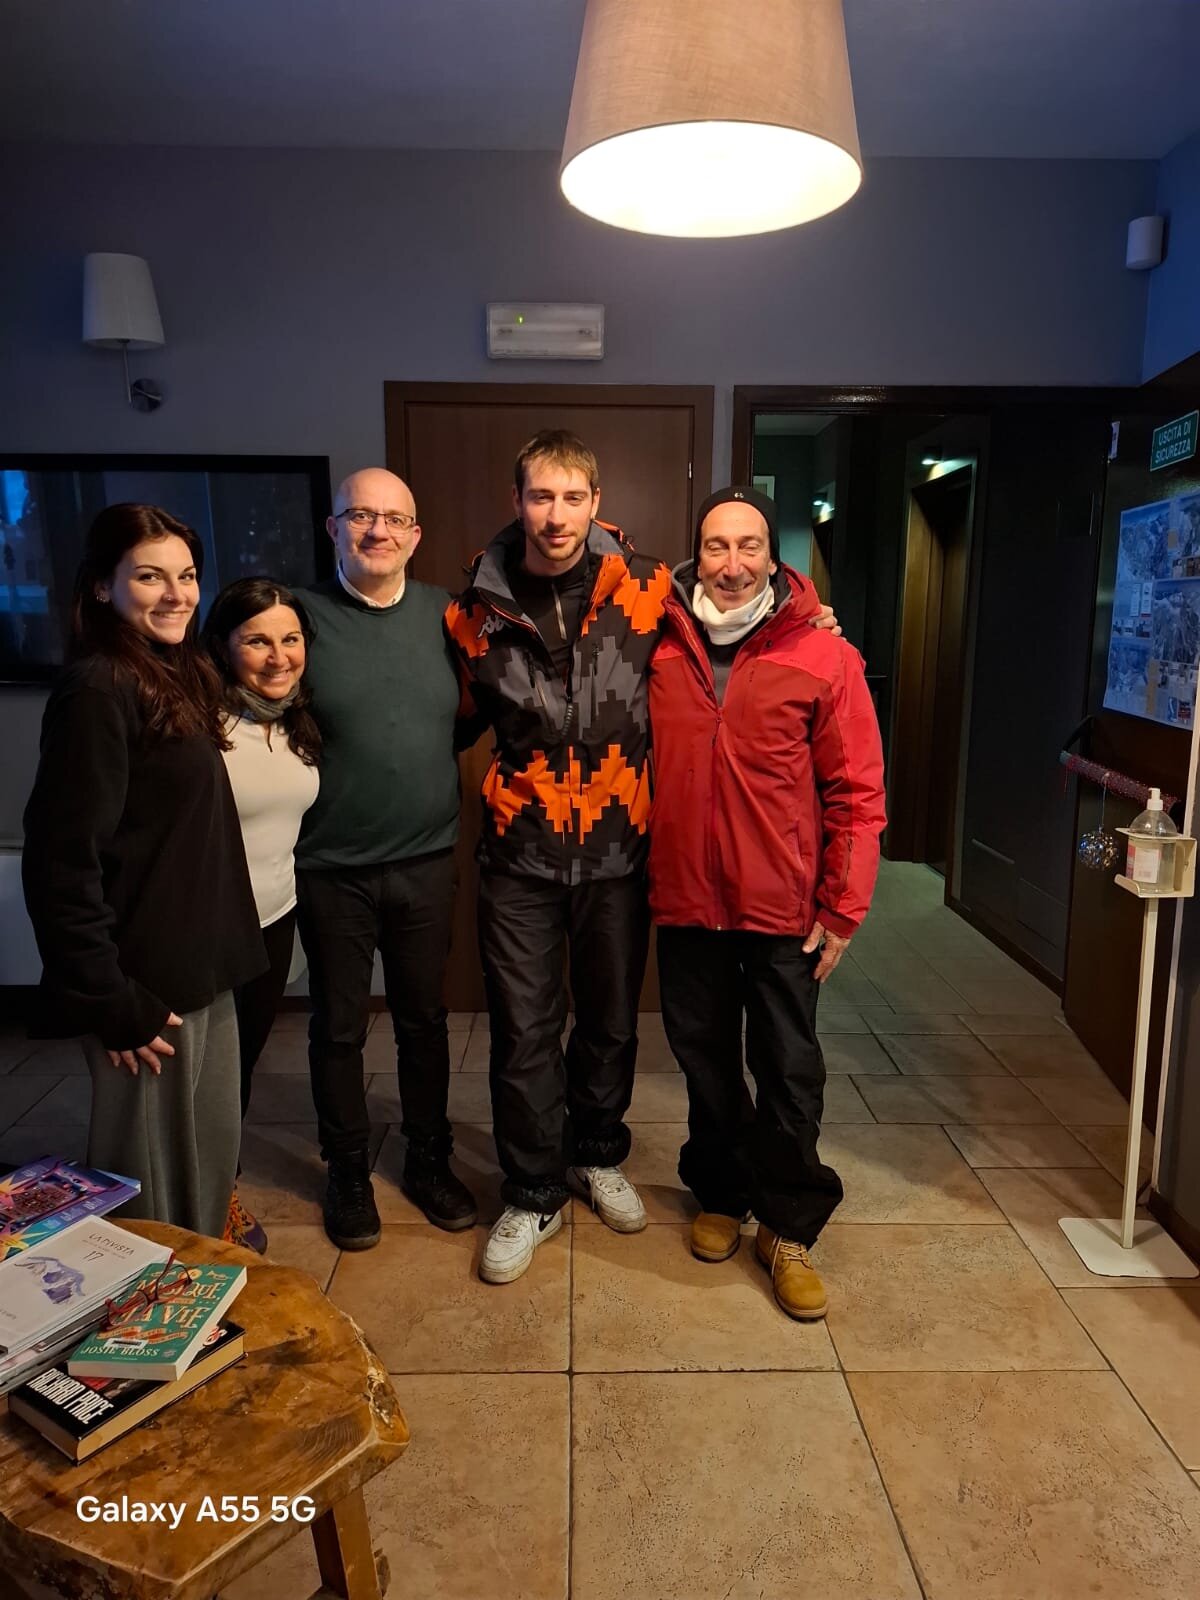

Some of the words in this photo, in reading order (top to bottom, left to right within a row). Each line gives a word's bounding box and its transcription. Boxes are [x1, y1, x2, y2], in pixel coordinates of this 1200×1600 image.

[1158, 423, 1182, 447] USCITA
[1183, 420, 1192, 436] DI
[1155, 438, 1191, 464] SICUREZZA
[162, 1305, 212, 1329] VIE
[80, 1345, 116, 1355] JOSIE
[119, 1346, 160, 1357] BLOSS
[25, 1367, 87, 1406] RICHARD
[63, 1389, 115, 1425] PRICE
